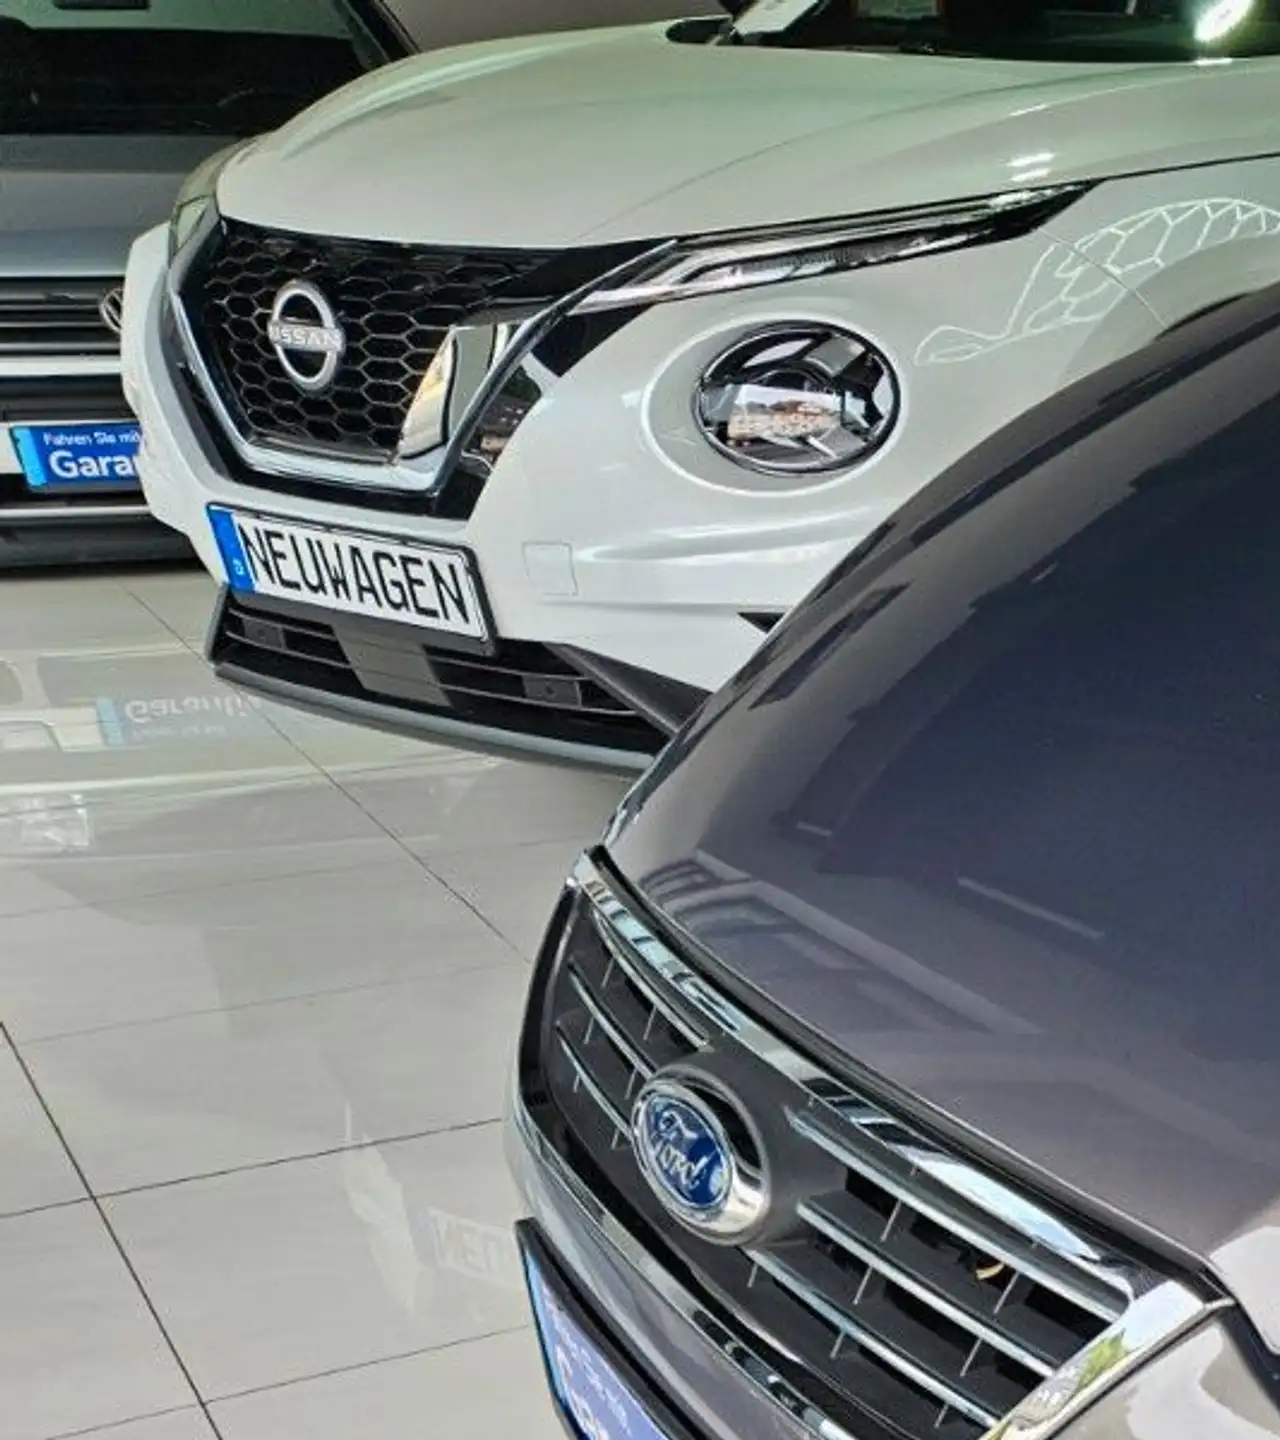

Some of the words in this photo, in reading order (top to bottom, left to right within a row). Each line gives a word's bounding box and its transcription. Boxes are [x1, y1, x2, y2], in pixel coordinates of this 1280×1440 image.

[49, 450, 138, 479] Gara
[238, 522, 470, 624] NEUWAGEN
[650, 1108, 720, 1192] Ford
